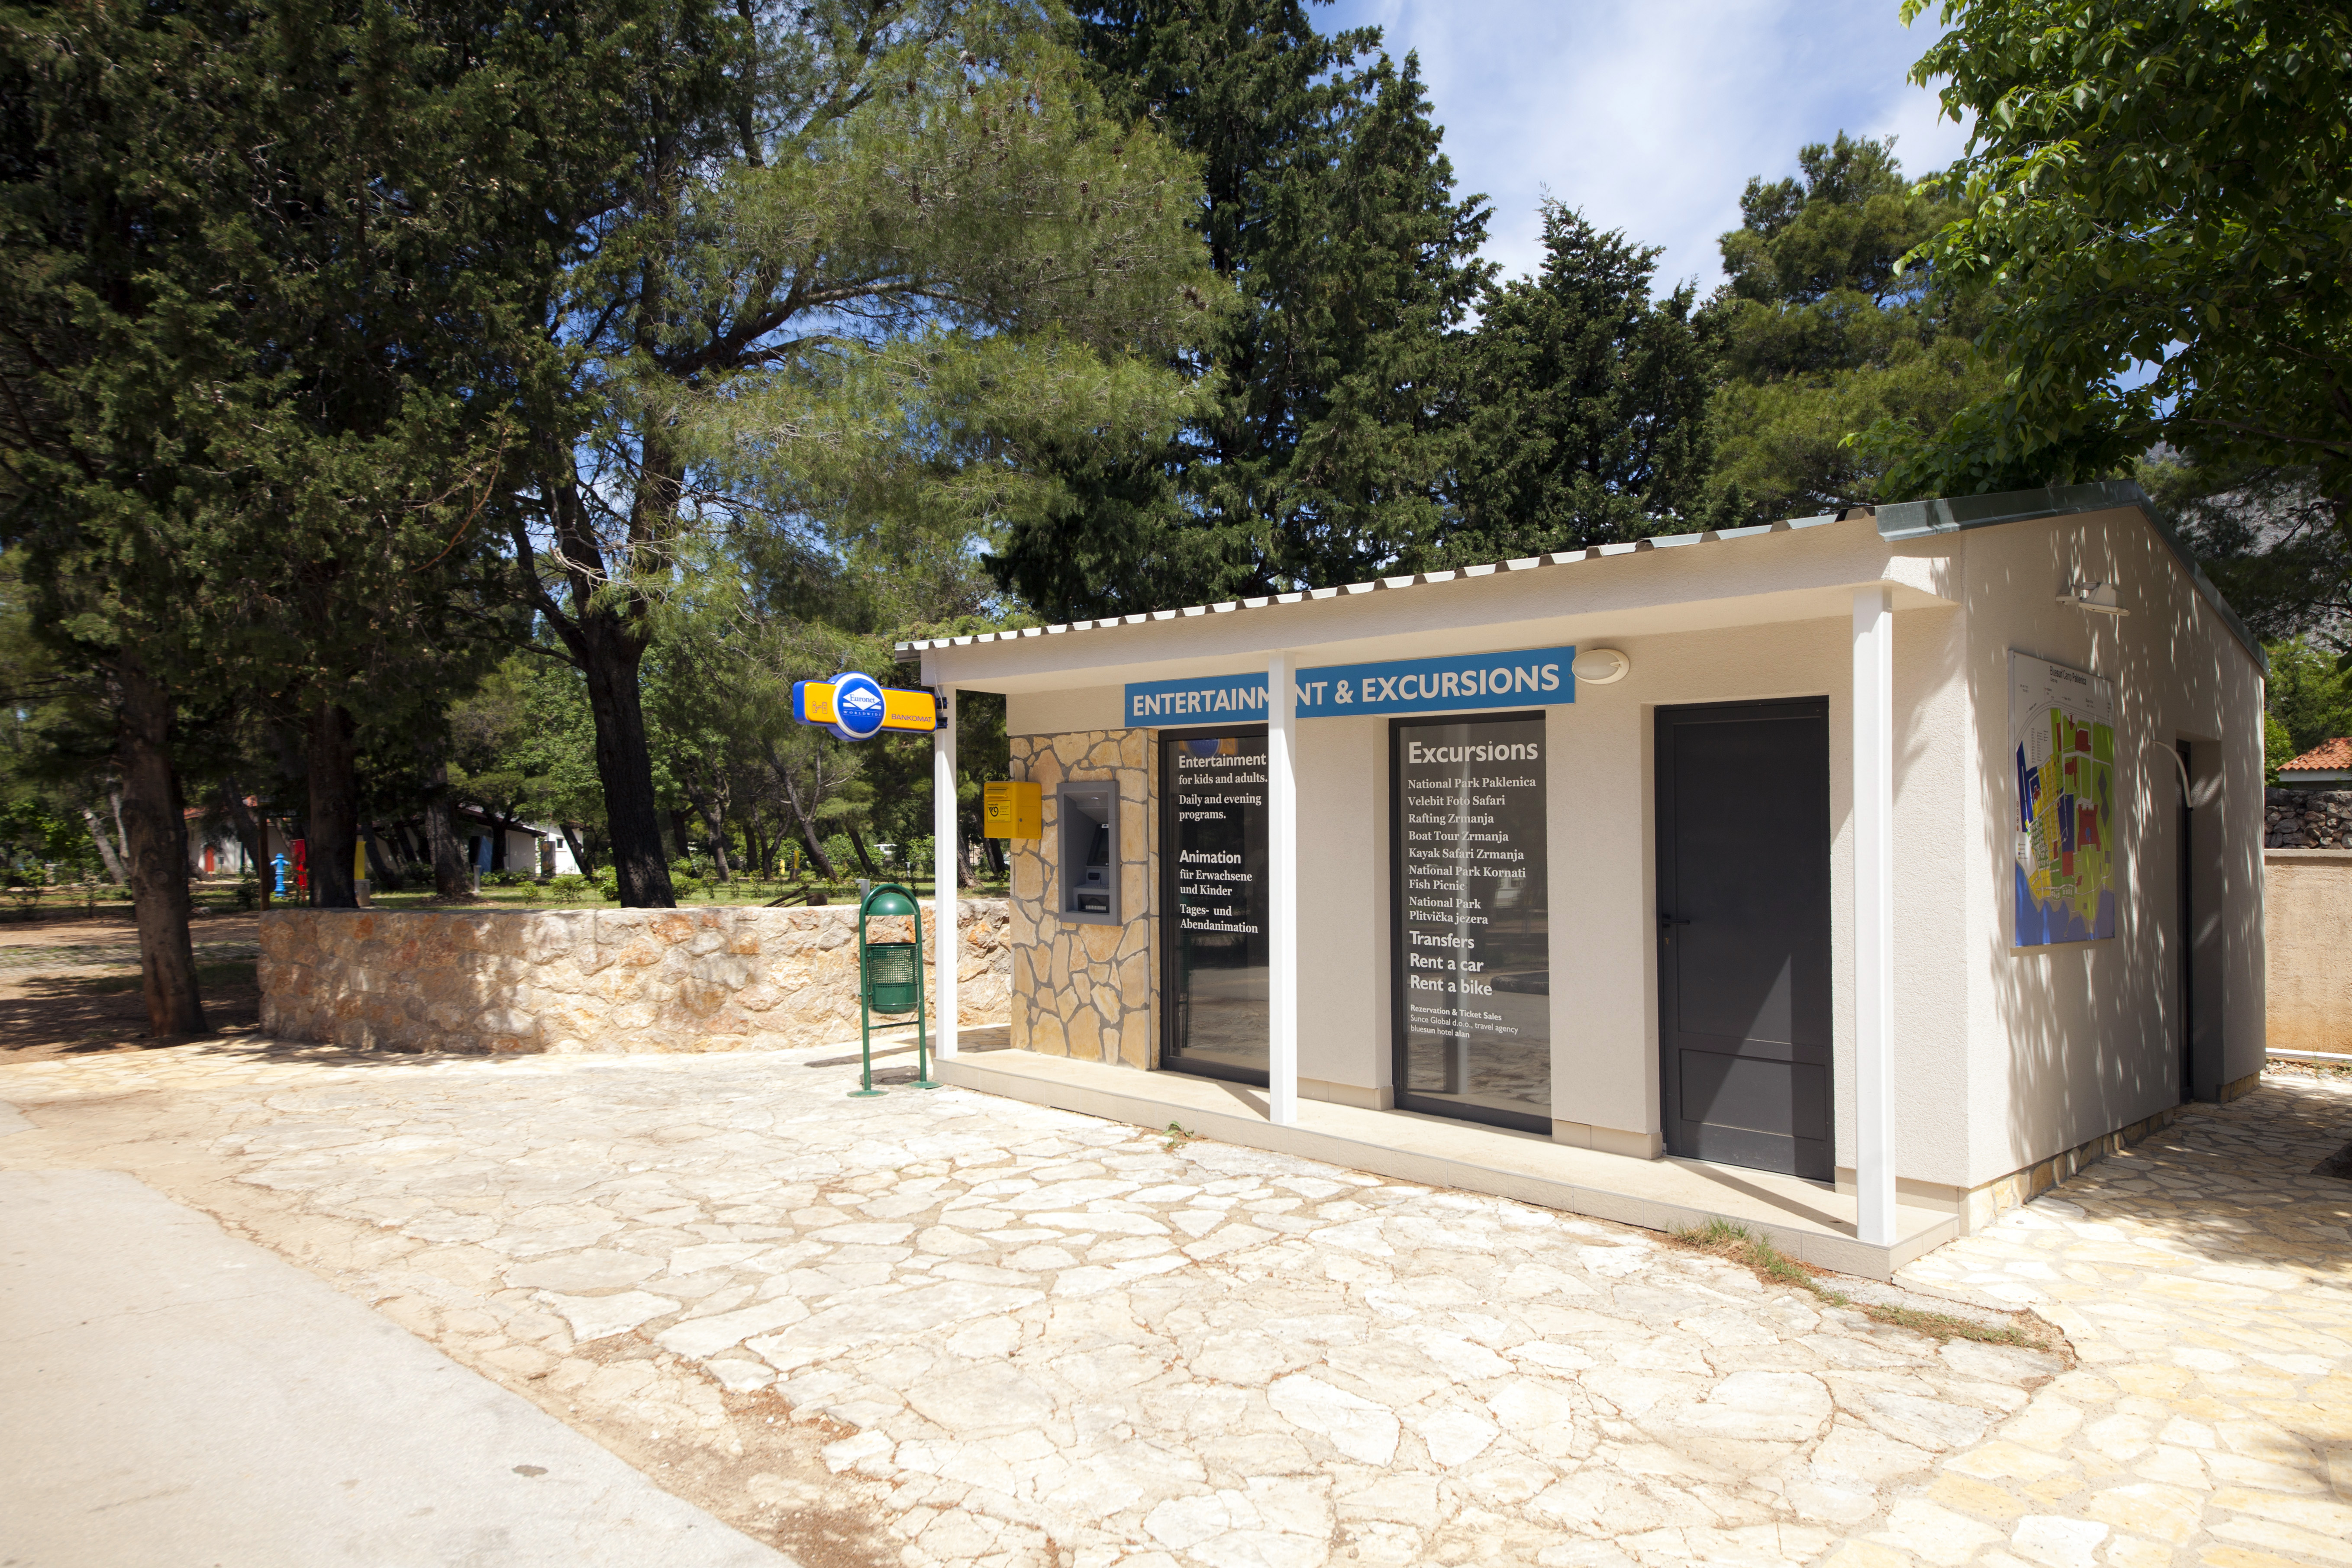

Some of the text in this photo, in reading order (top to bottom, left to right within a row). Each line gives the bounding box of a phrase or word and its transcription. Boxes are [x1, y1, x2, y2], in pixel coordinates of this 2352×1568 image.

[2063, 670, 2071, 683] Camp
[2072, 672, 2087, 685] Paklenica
[1133, 664, 1559, 716] ENTERTAINMNT & EXCURSIONS
[850, 694, 875, 703] Euronet
[892, 713, 932, 722] BANKOMAT
[1409, 741, 1538, 764] Excursions
[1179, 753, 1266, 768] Entertainment
[1178, 772, 1268, 784] for kids and adults.
[1408, 776, 1536, 788] National Park Paklenica
[1179, 793, 1261, 807] Daily and evening
[1408, 795, 1505, 806] Velebit Foto Safari
[1179, 809, 1226, 822] programs.
[1408, 813, 1494, 826] Rafting Zrmanja
[1408, 831, 1509, 843] Boat Tour Zrmanja
[1179, 850, 1241, 864] Animation
[1409, 848, 1524, 861] Kayak Safari Zrmanja
[1180, 869, 1252, 881] für Erwachsene
[1409, 865, 1526, 878] National Park Kornati
[1180, 884, 1232, 896] und Kinder
[1409, 879, 1465, 890] Fish Picnic
[1409, 896, 1481, 909] National Park
[1180, 904, 1232, 916] Tages- und
[1410, 910, 1488, 925] Plitvička jezera
[1180, 919, 1258, 933] Abendanimation
[1410, 930, 1474, 949] Transfers
[1410, 953, 1484, 972] Rent a car
[1410, 974, 1493, 996] Rent a bike
[1410, 1004, 1450, 1016] Rezervation
[1459, 1009, 1481, 1019] Ticket
[1483, 1012, 1502, 1020] Sales
[1410, 1014, 1429, 1023] Sunce
[1430, 1016, 1451, 1025] Global
[1452, 1020, 1473, 1029] d.o.o.,
[1495, 1025, 1518, 1035] agency
[1411, 1025, 1436, 1034] bluesun
[1437, 1027, 1453, 1036] hotel
